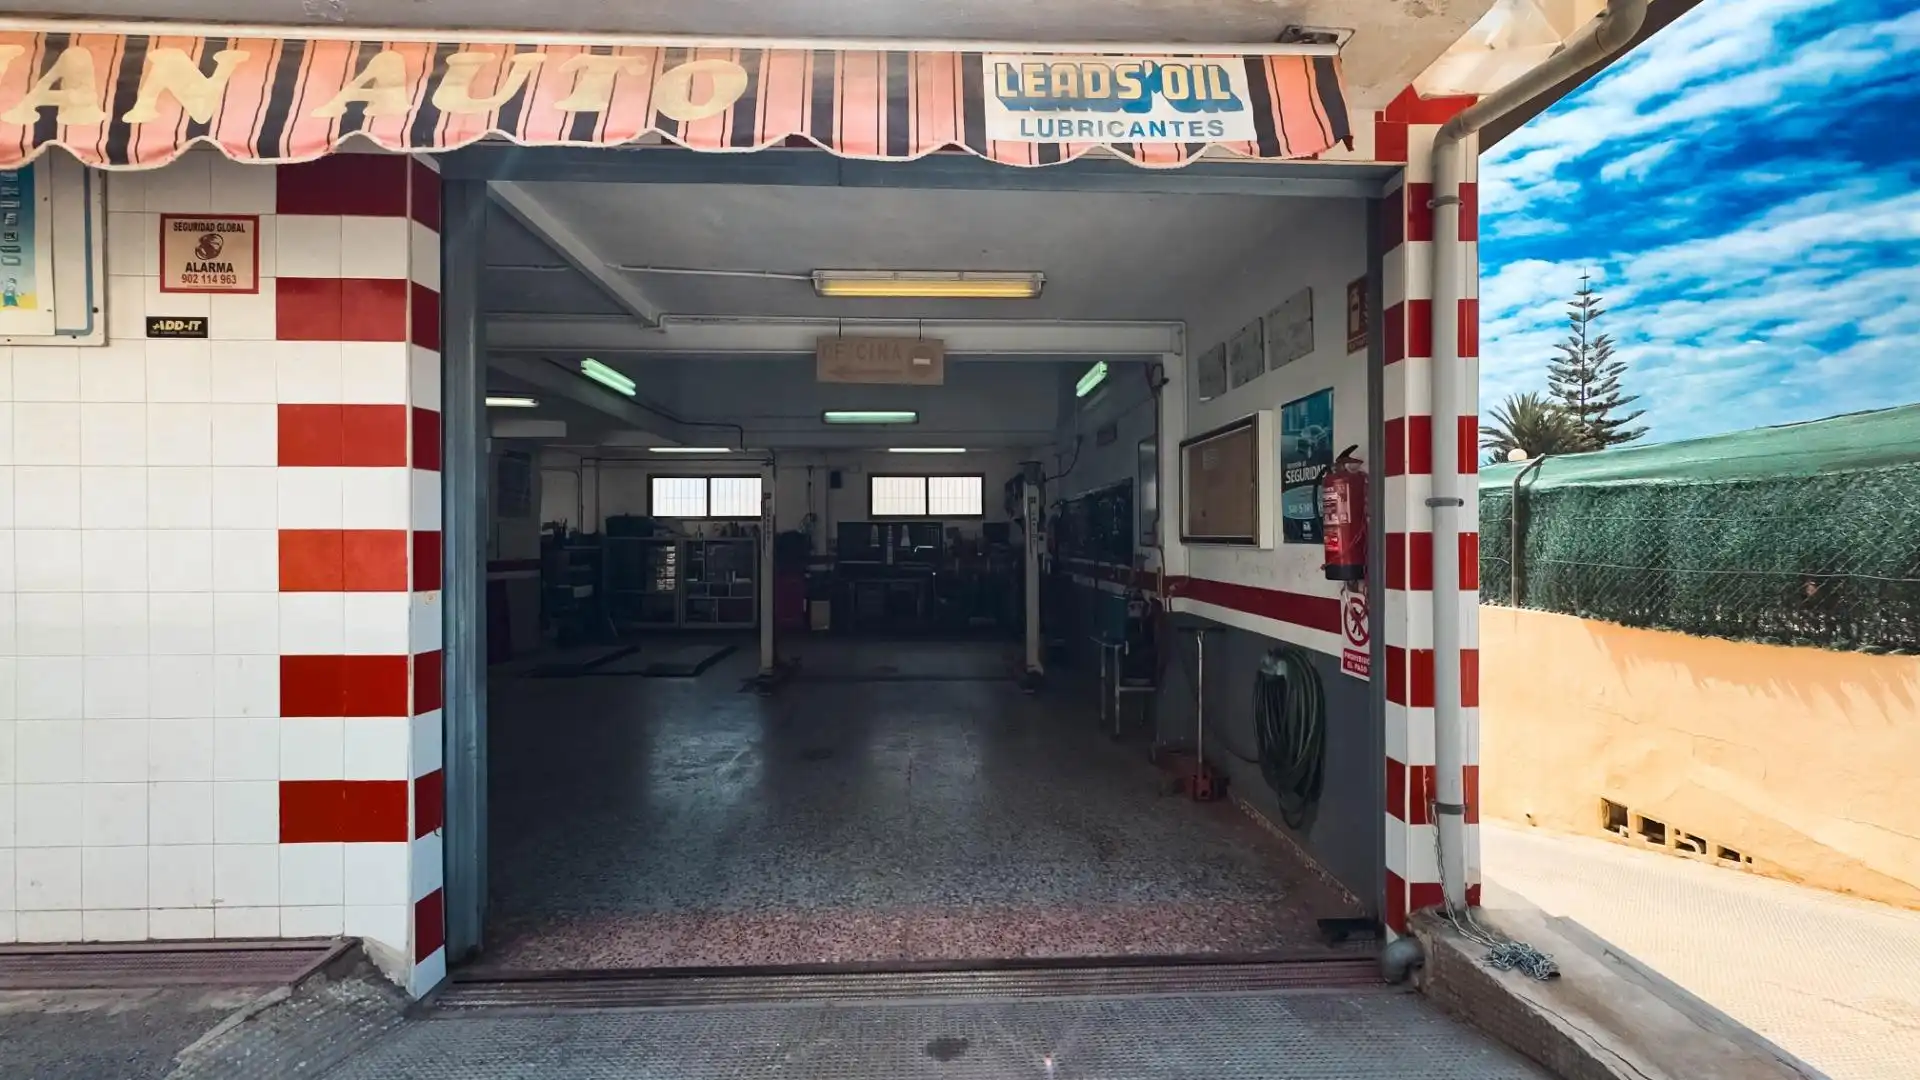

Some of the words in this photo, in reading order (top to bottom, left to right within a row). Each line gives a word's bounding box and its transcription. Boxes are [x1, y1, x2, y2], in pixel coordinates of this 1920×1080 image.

[311, 50, 748, 122] AUTO
[995, 60, 1242, 112] LEADS'OIL
[1021, 118, 1224, 137] LUBRICANTES
[173, 221, 215, 232] SEGURIDAD
[216, 222, 246, 233] GLOBAL
[185, 262, 234, 273] ALARMA
[181, 274, 199, 284] 902
[202, 274, 218, 284] 114
[220, 274, 237, 284] 963
[152, 320, 202, 331] ADD-IT
